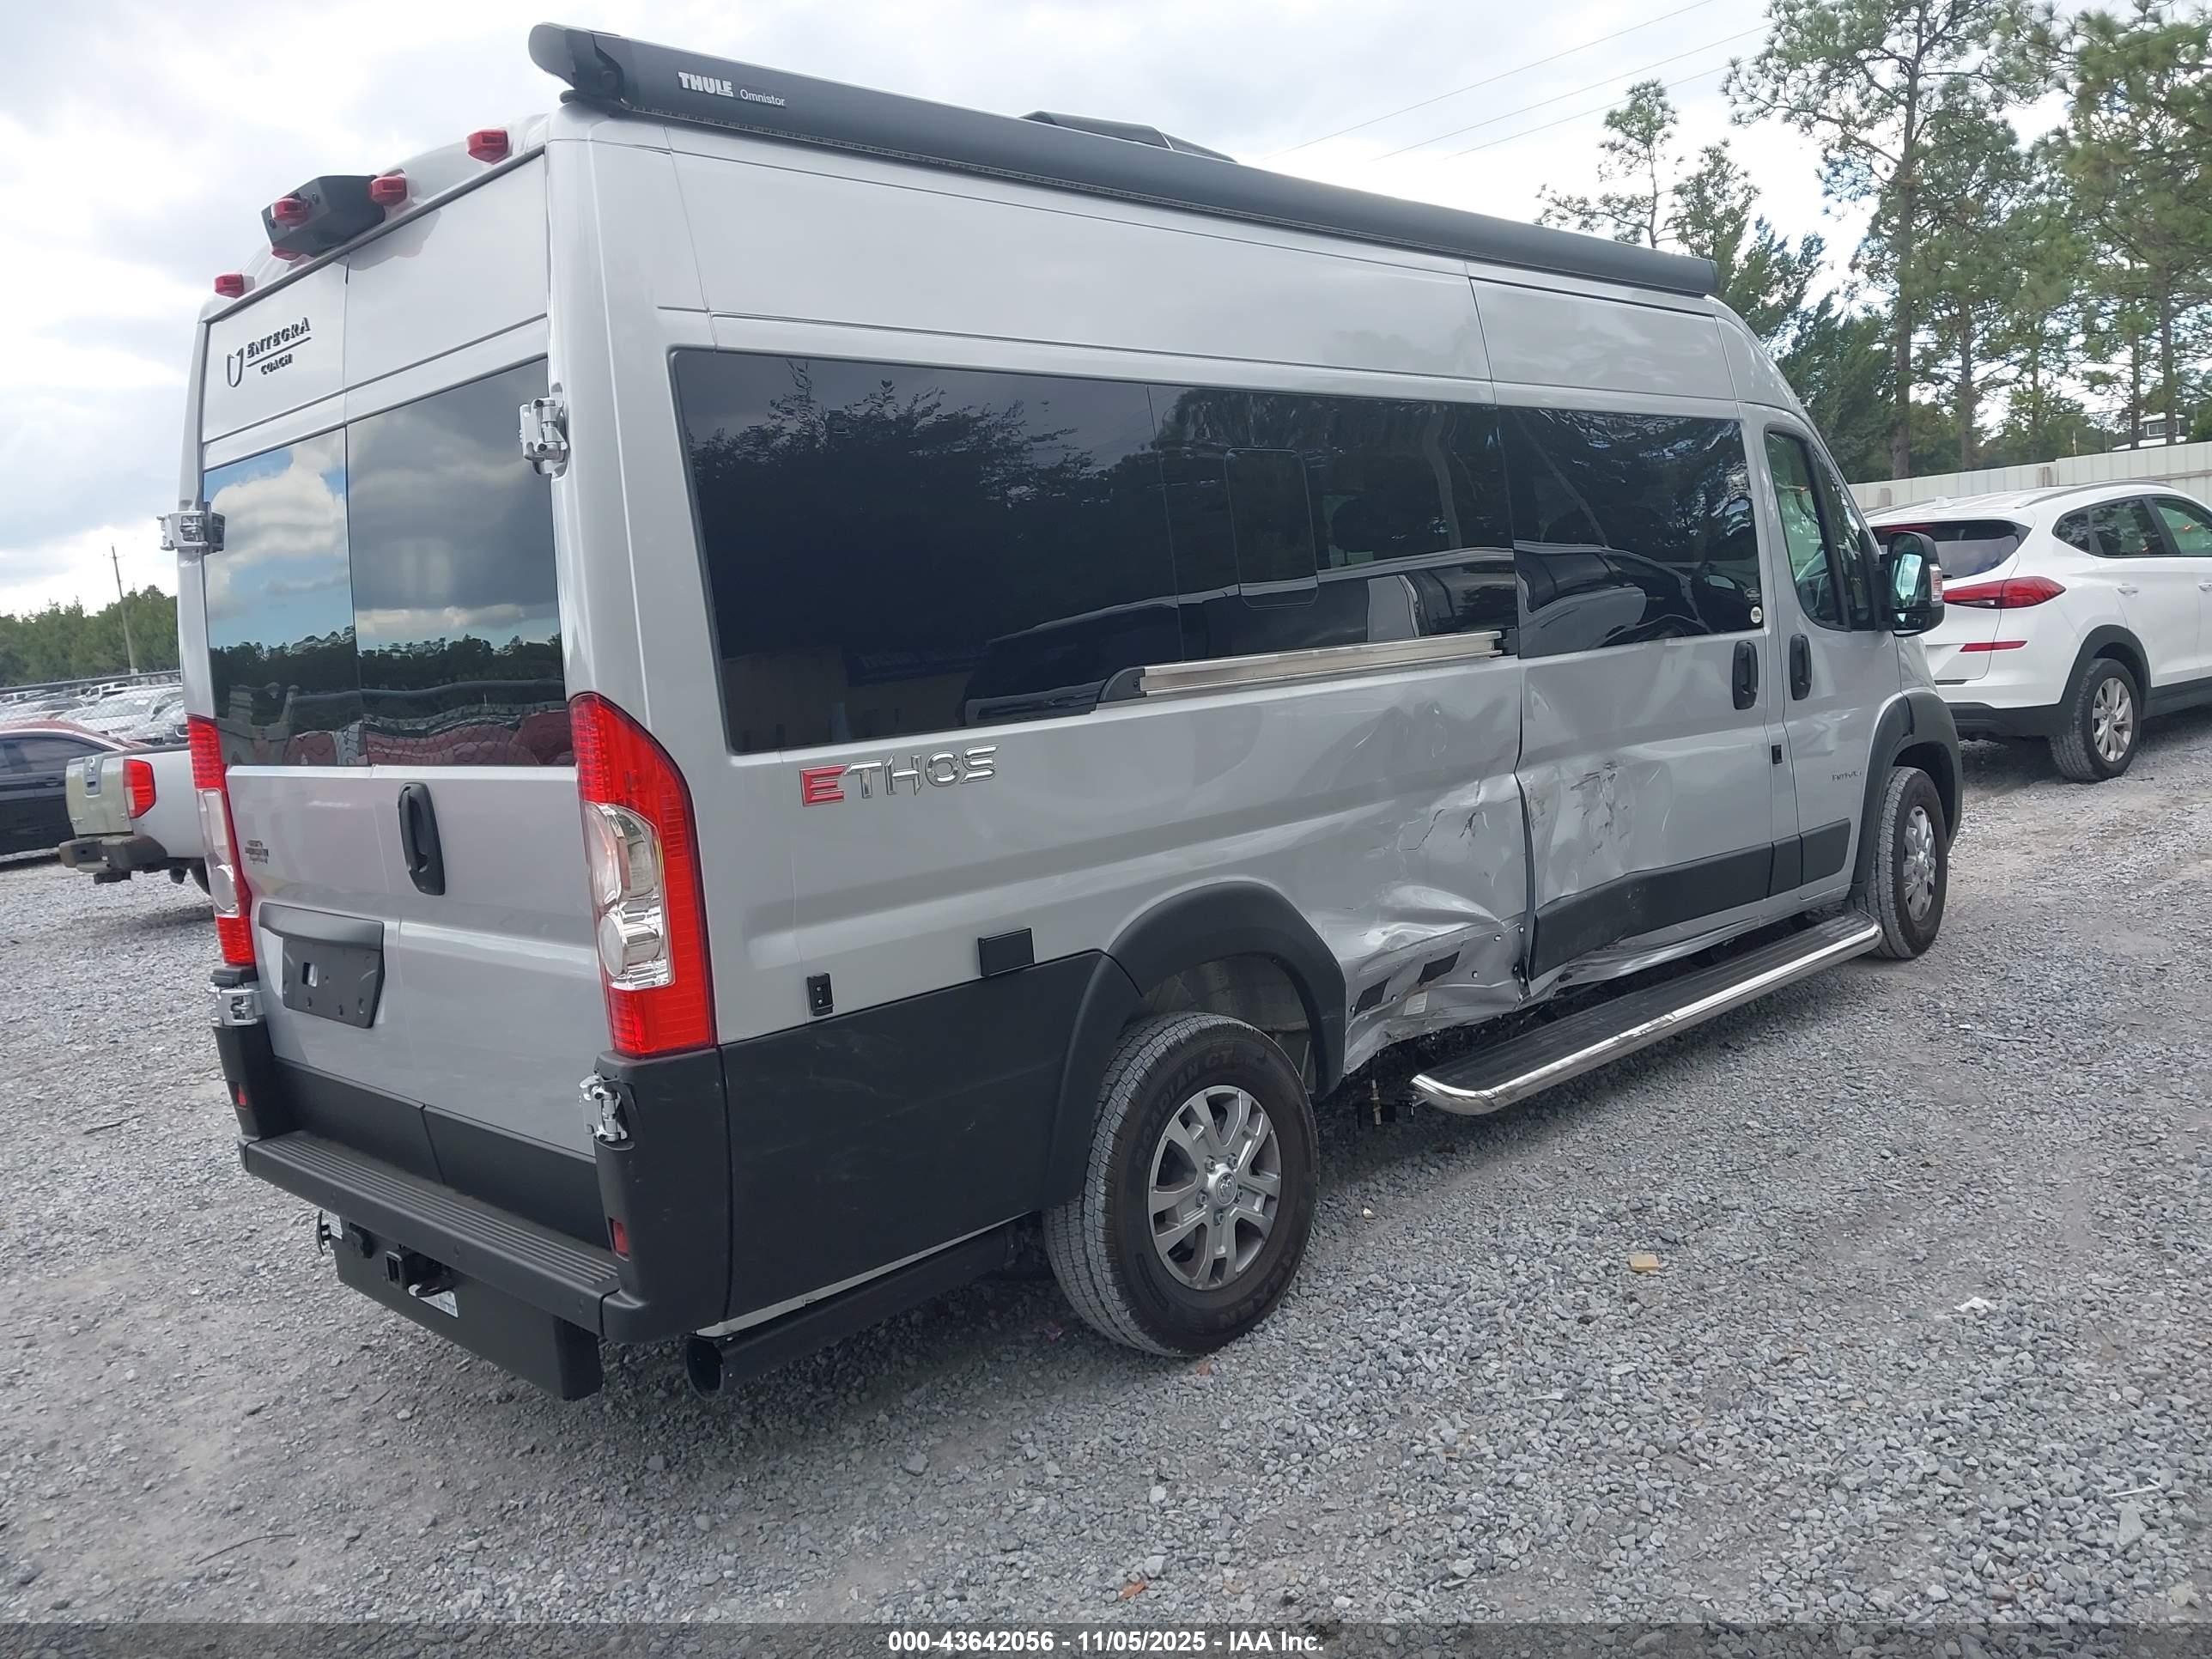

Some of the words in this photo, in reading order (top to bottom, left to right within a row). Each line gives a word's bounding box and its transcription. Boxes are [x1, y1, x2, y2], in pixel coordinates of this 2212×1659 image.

[678, 71, 734, 97] THULE
[739, 88, 786, 106] Omnistor
[247, 317, 311, 358] ENTEGRA
[260, 354, 293, 375] COACH
[799, 744, 999, 806] ETHOS
